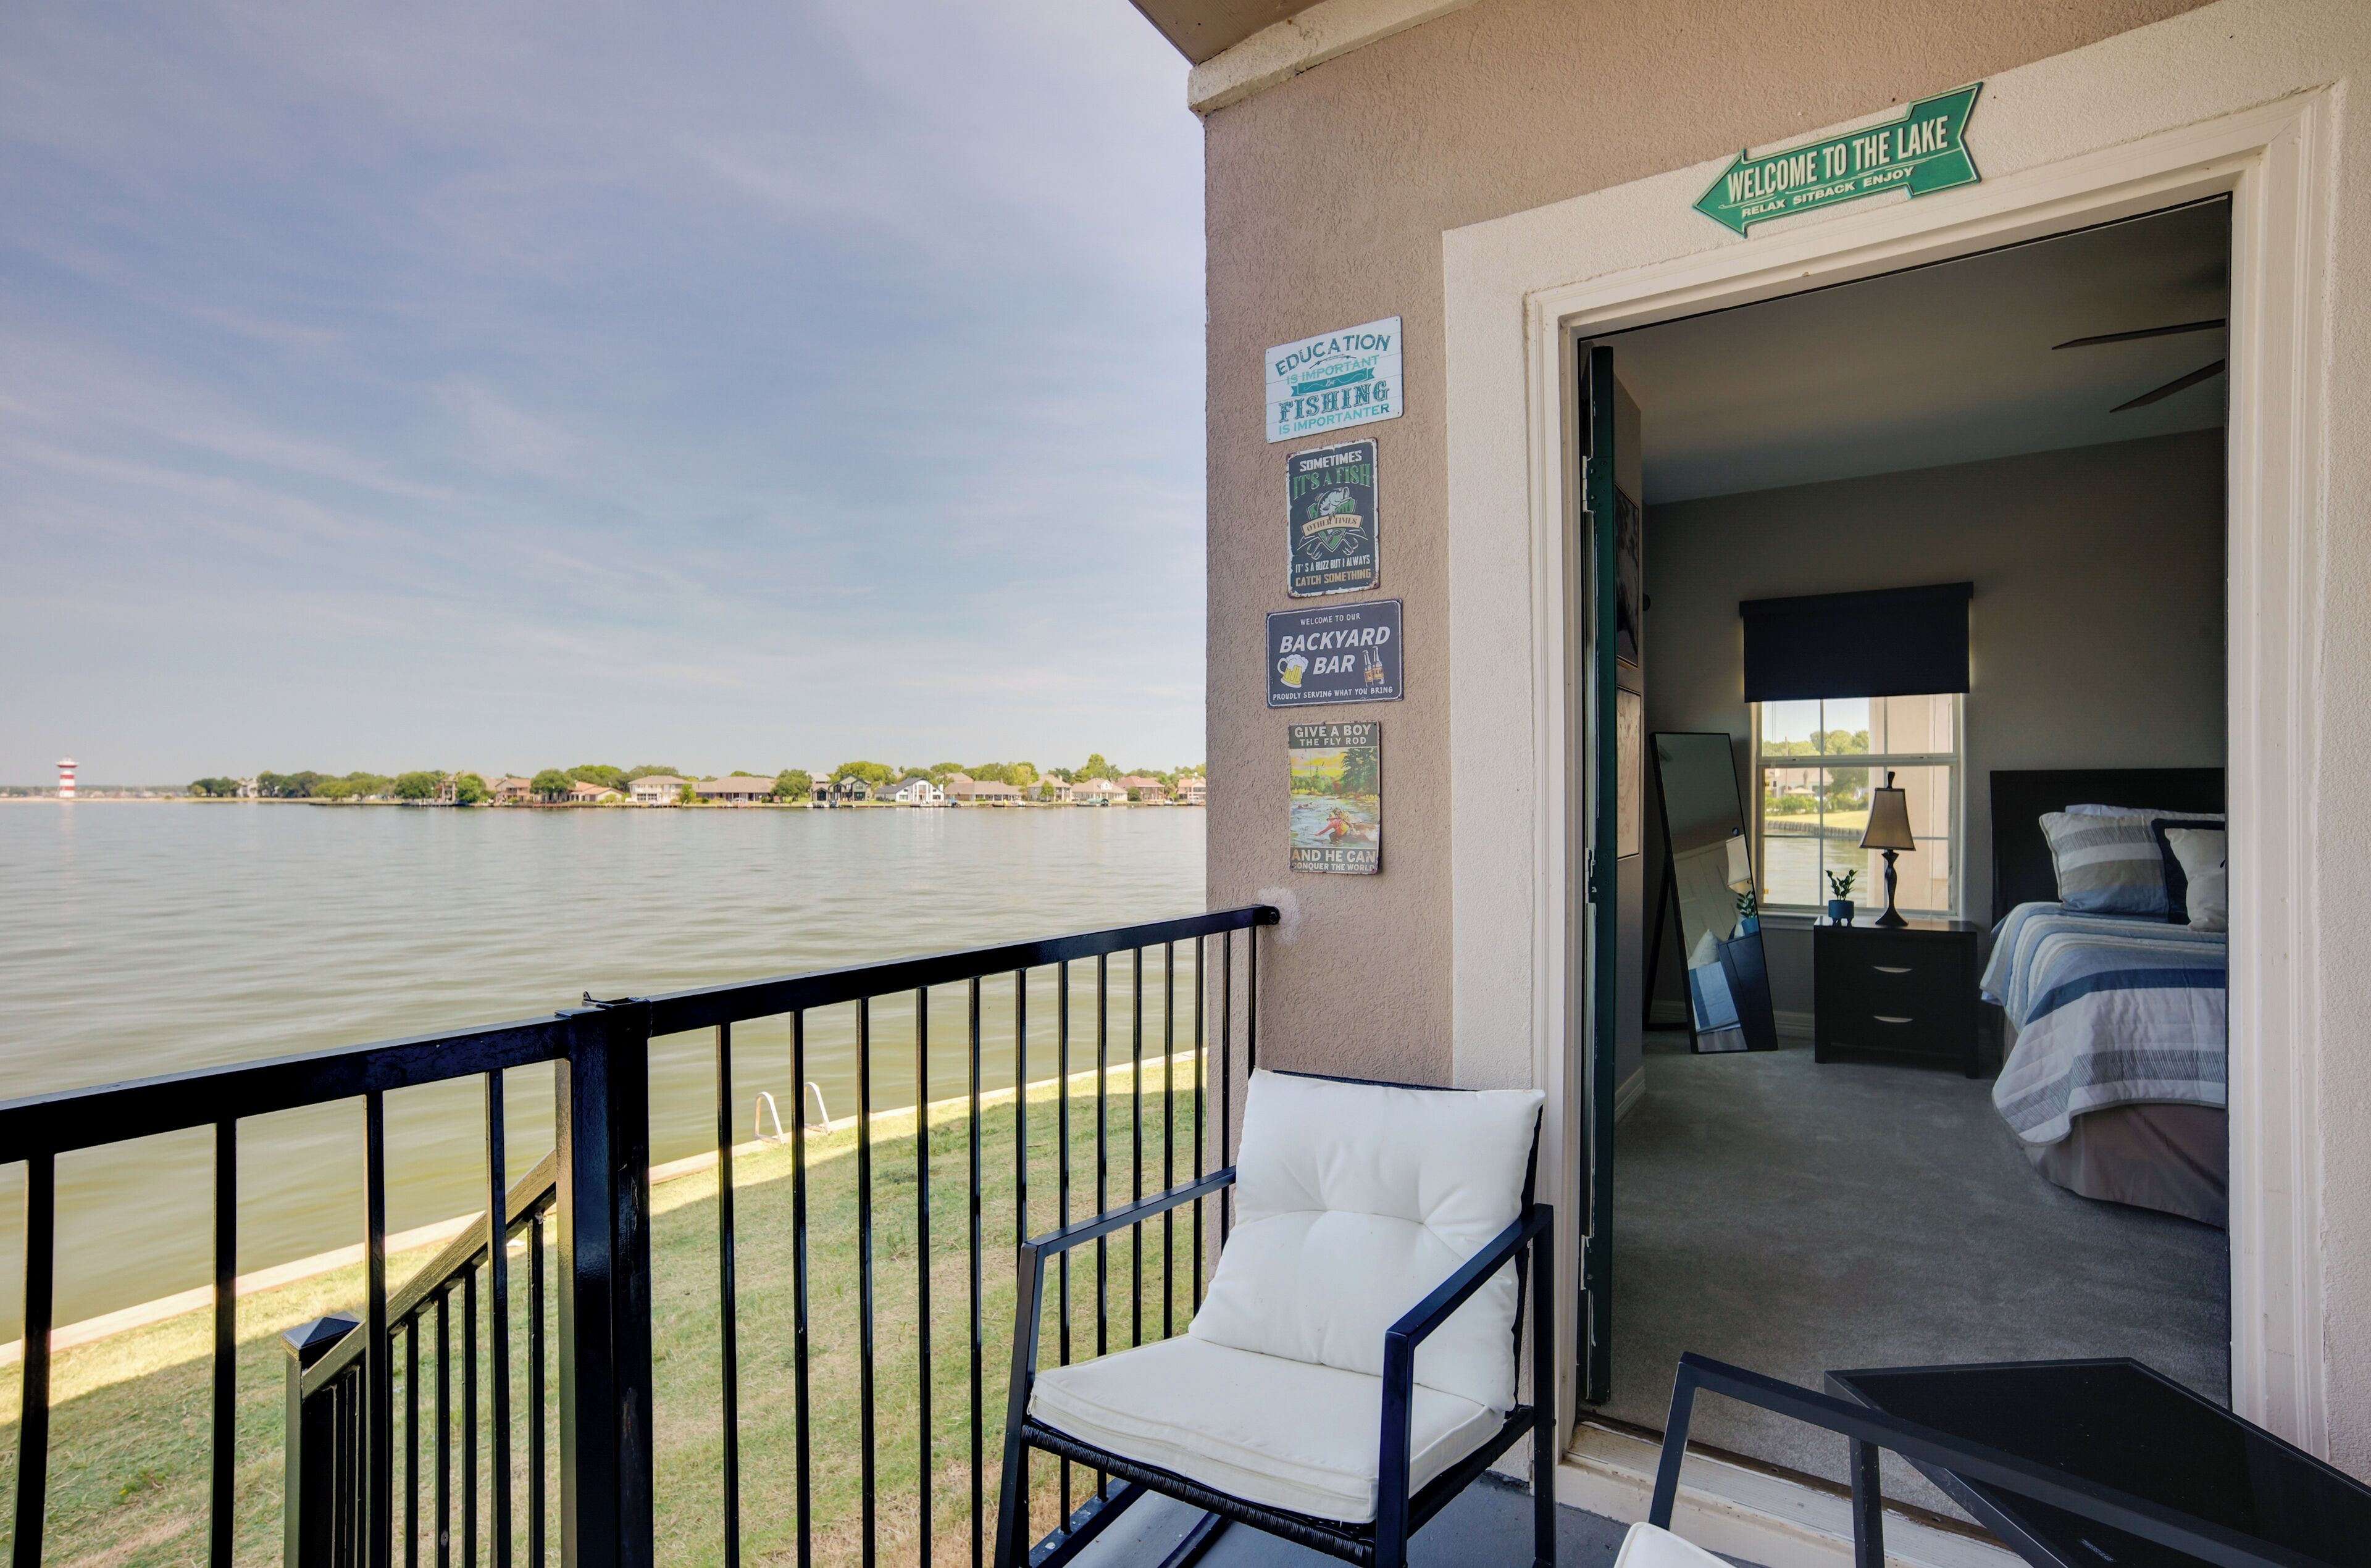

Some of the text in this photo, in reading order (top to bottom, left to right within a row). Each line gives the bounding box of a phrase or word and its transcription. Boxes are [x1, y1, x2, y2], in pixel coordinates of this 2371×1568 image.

[1728, 115, 1949, 203] WELCOME TO THE LAKE
[1741, 167, 1914, 217] RELAX SITBACK ENJOY
[1275, 334, 1390, 377] EDUCATION
[1287, 354, 1380, 385] IS IMPORTANT
[1279, 380, 1390, 423] FISHING
[1279, 403, 1389, 435] IS IMPORTANTER
[1300, 450, 1362, 472] SOMETIMES
[1292, 464, 1371, 500] IT'S A FISH
[1307, 519, 1332, 532] OTHER
[1310, 562, 1315, 572] A
[1316, 560, 1329, 570] BUZZ
[1330, 559, 1341, 569] BUT
[1342, 558, 1345, 567] I
[1346, 554, 1370, 567] ALWAYS
[1295, 569, 1371, 587] CATCH SOMETHING
[1300, 615, 1332, 625] WELCOME
[1279, 626, 1390, 653] BACKYARD
[1313, 654, 1355, 675] BAR
[1273, 691, 1301, 701] PROUDLY
[1303, 690, 1332, 699] SERVING
[1334, 689, 1352, 697] WHAT
[1294, 724, 1371, 738] GIVE A BOY
[1300, 738, 1319, 746] THE
[1324, 738, 1342, 746] FLY
[1292, 849, 1376, 863] AND HE CAN
[1292, 862, 1329, 870] CONQUER
